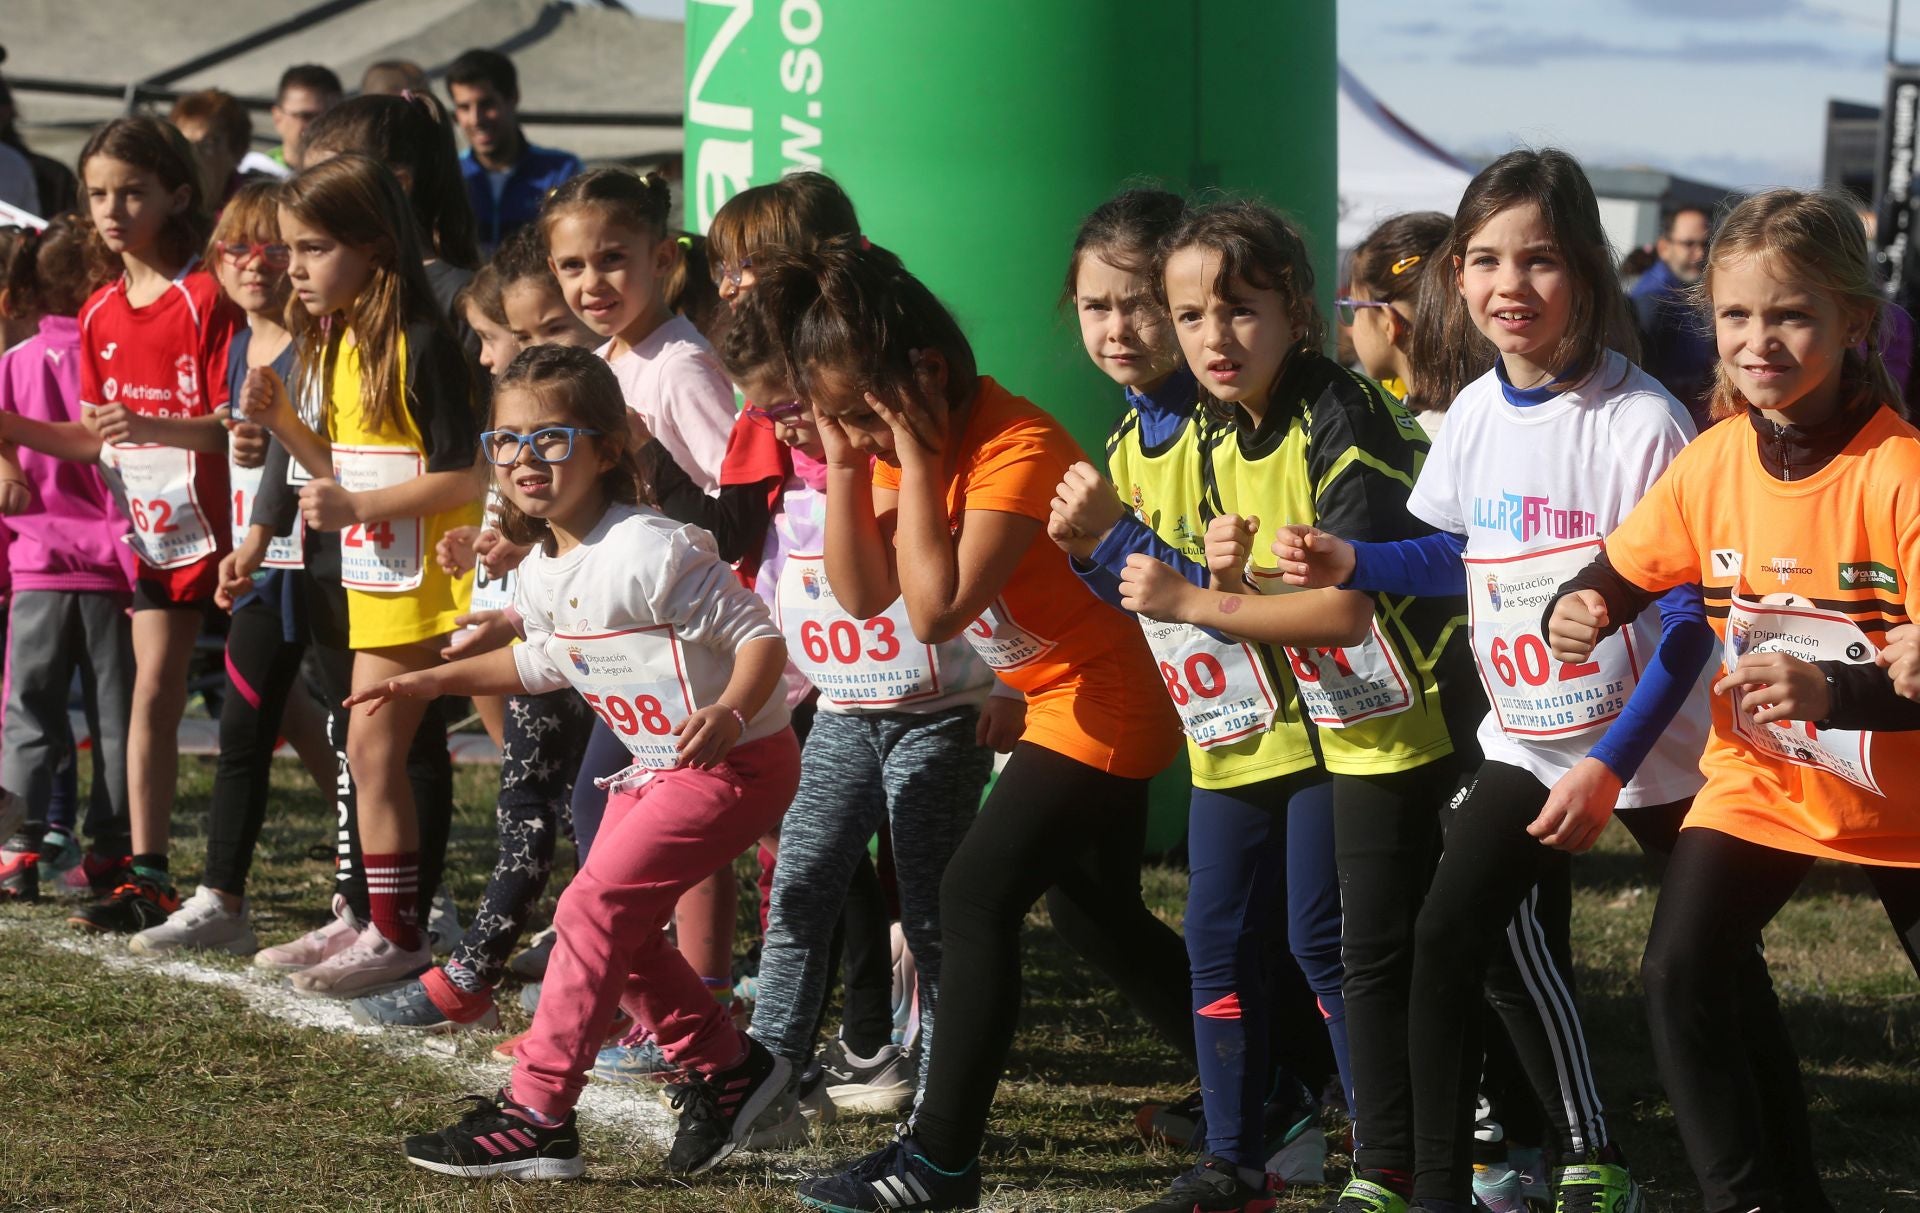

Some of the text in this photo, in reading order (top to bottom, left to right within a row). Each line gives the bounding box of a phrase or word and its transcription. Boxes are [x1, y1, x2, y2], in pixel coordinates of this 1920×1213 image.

[131, 498, 179, 535] 62
[1500, 576, 1555, 602] Diputación
[1503, 599, 1515, 609] de
[800, 616, 901, 665] 603
[1753, 630, 1819, 648] Diputación
[585, 653, 628, 664] Diputación
[591, 666, 633, 677] de Segovia
[817, 674, 844, 685] CROSS
[844, 669, 902, 685] NACIONAL
[904, 668, 921, 680] DE
[1160, 652, 1227, 707] 80
[887, 682, 920, 698] 2025
[1370, 678, 1388, 691] DE
[1239, 697, 1257, 709] DE
[1356, 691, 1393, 712] 2025
[1534, 687, 1603, 711] NACIONAL
[1604, 680, 1625, 696] DE
[582, 691, 673, 736] 598
[1224, 711, 1259, 732] 2025
[1506, 711, 1575, 728] CANTIMPALOS
[1586, 697, 1625, 720] 2025
